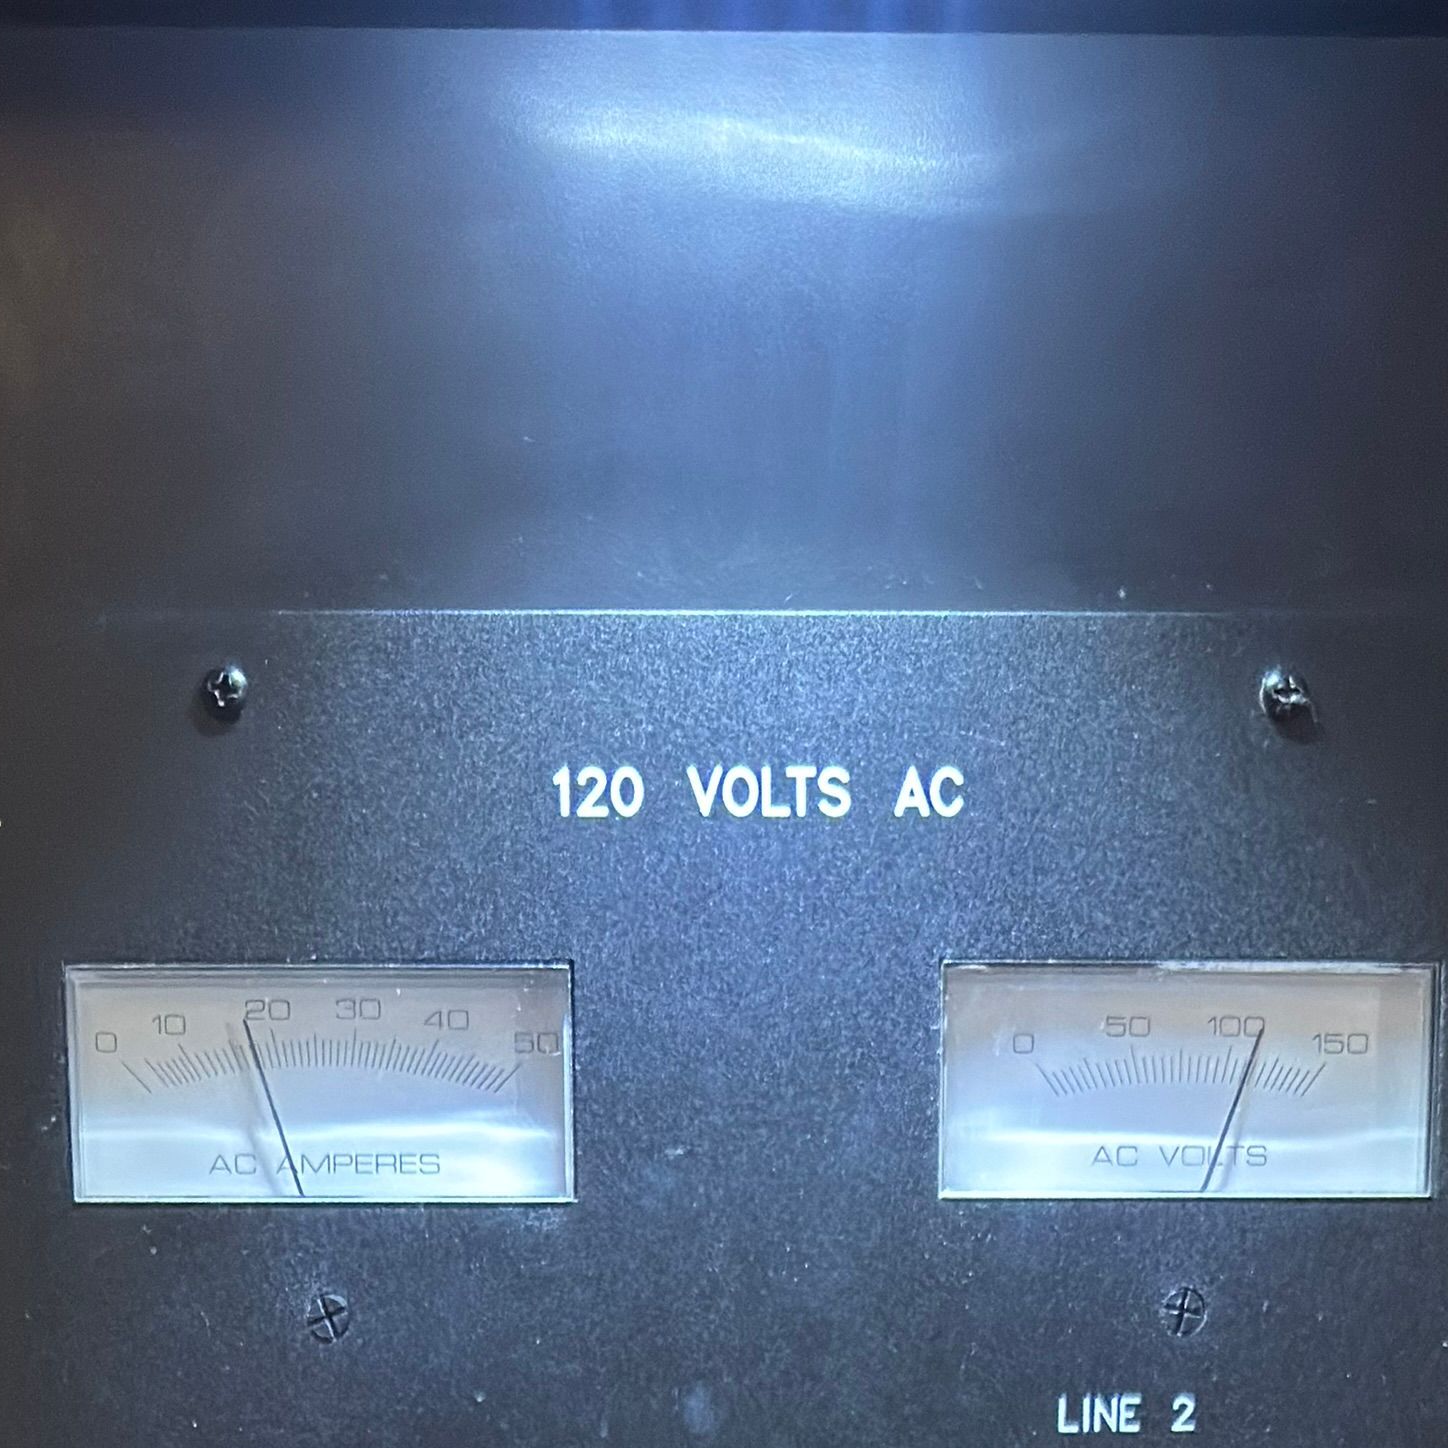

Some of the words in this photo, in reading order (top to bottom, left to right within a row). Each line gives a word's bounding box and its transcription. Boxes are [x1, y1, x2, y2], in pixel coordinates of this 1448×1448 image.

[553, 762, 644, 817] 120
[686, 764, 853, 818] VOLTS
[894, 764, 964, 817] AC
[209, 1153, 259, 1175] AC
[275, 1153, 441, 1175] AMPERES
[1058, 1393, 1141, 1433] LINE
[1171, 1393, 1195, 1432] 2
